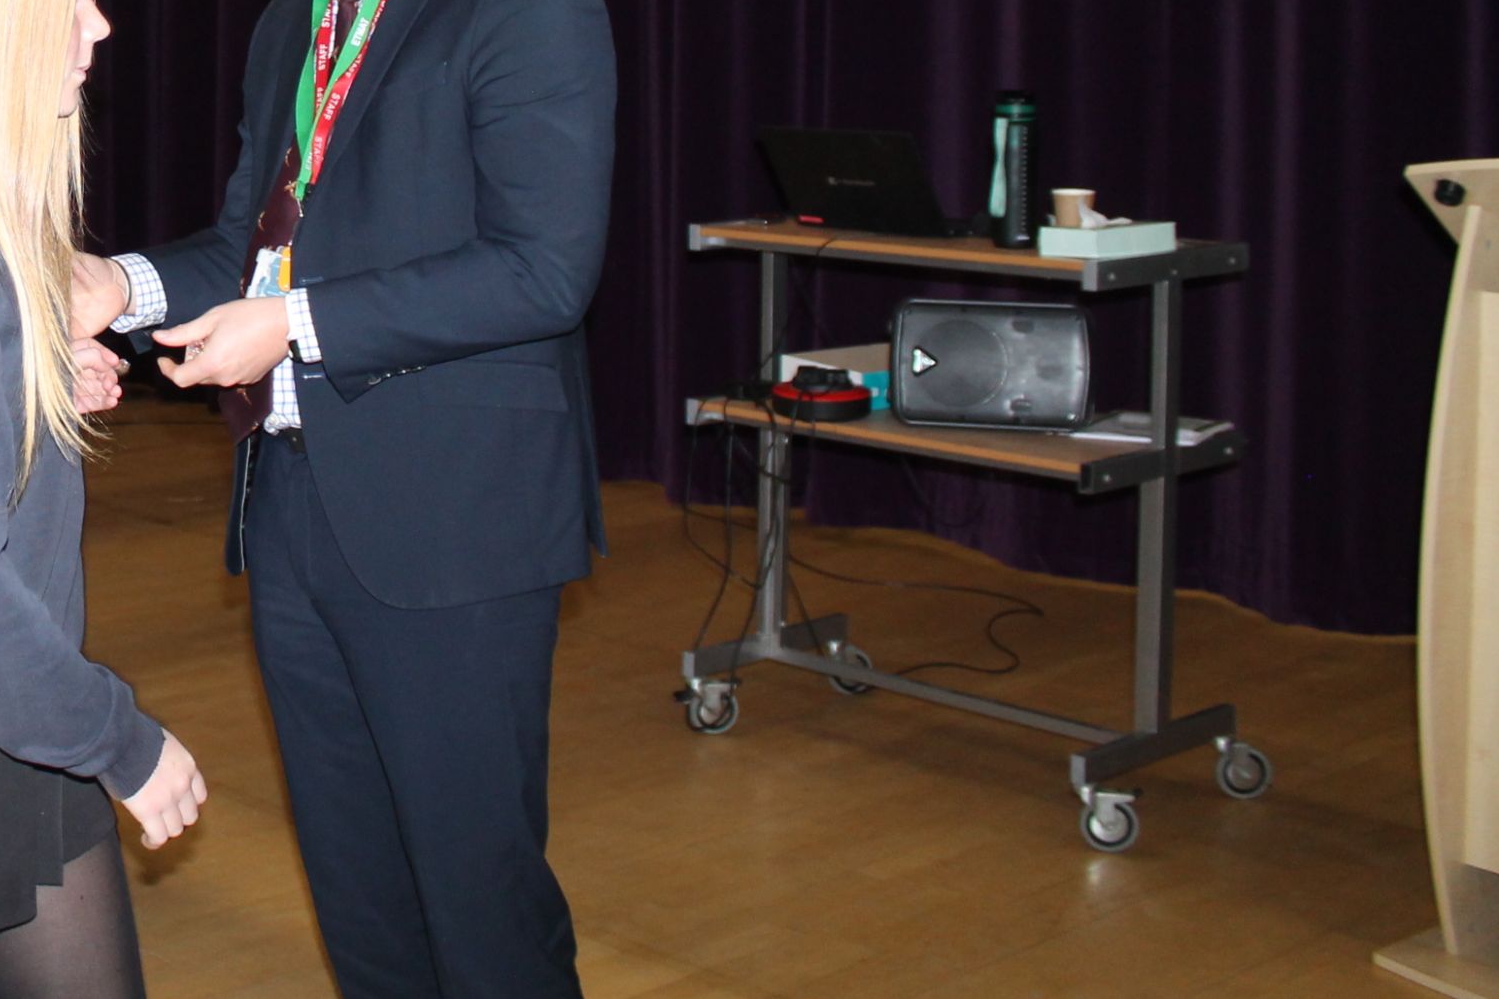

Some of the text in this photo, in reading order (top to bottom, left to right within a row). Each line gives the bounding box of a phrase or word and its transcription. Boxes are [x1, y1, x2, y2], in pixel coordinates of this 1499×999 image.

[351, 17, 369, 47] ETMAT
[318, 44, 328, 71] STAFF
[323, 93, 341, 121] STAFF
